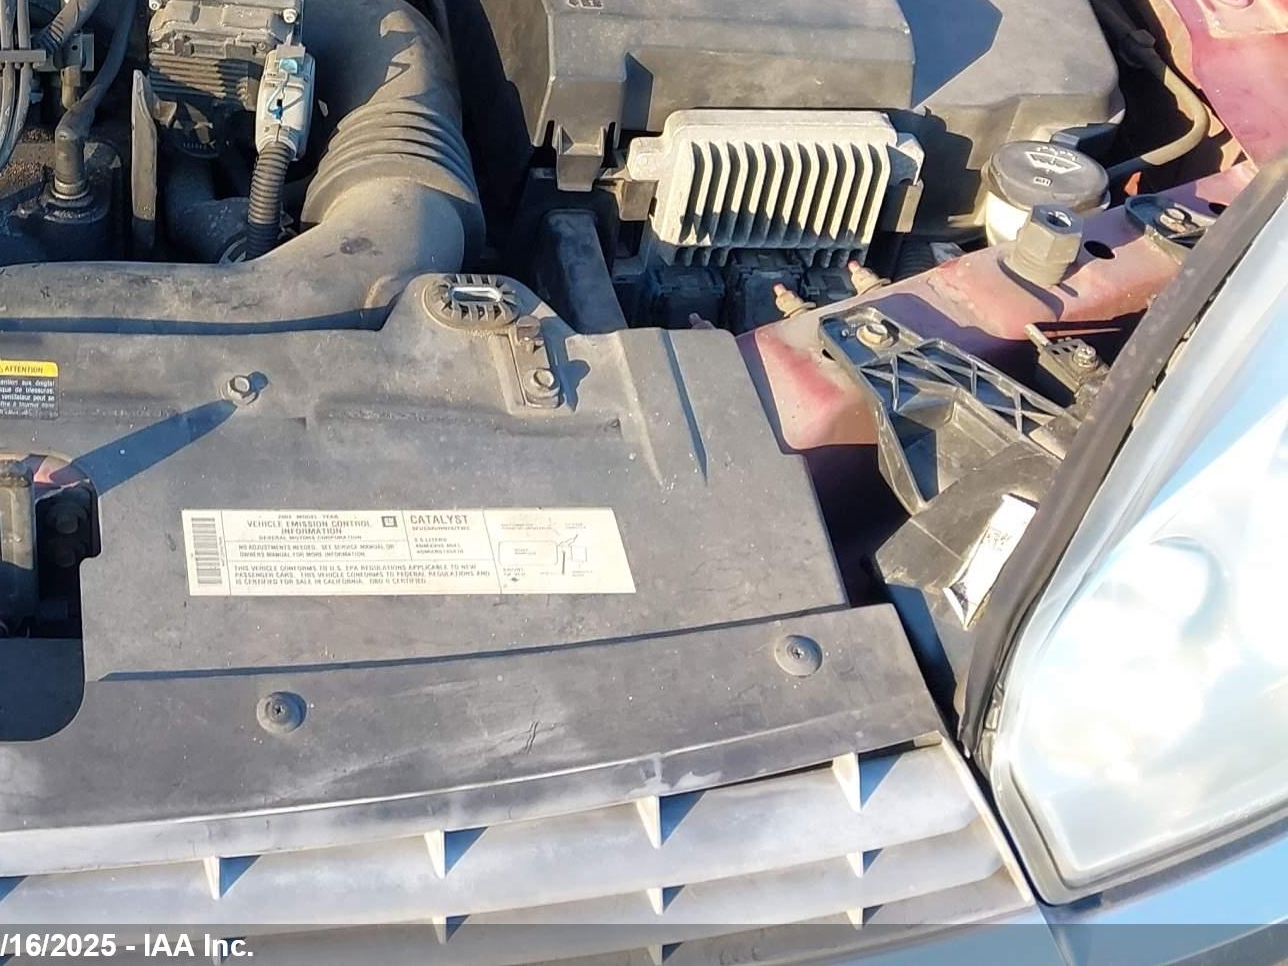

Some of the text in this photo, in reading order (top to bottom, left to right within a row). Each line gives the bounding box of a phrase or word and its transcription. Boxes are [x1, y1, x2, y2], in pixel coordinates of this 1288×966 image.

[5, 365, 43, 374] ATTENTION
[247, 520, 281, 528] VEHICLE
[410, 515, 468, 525] CATALYST
